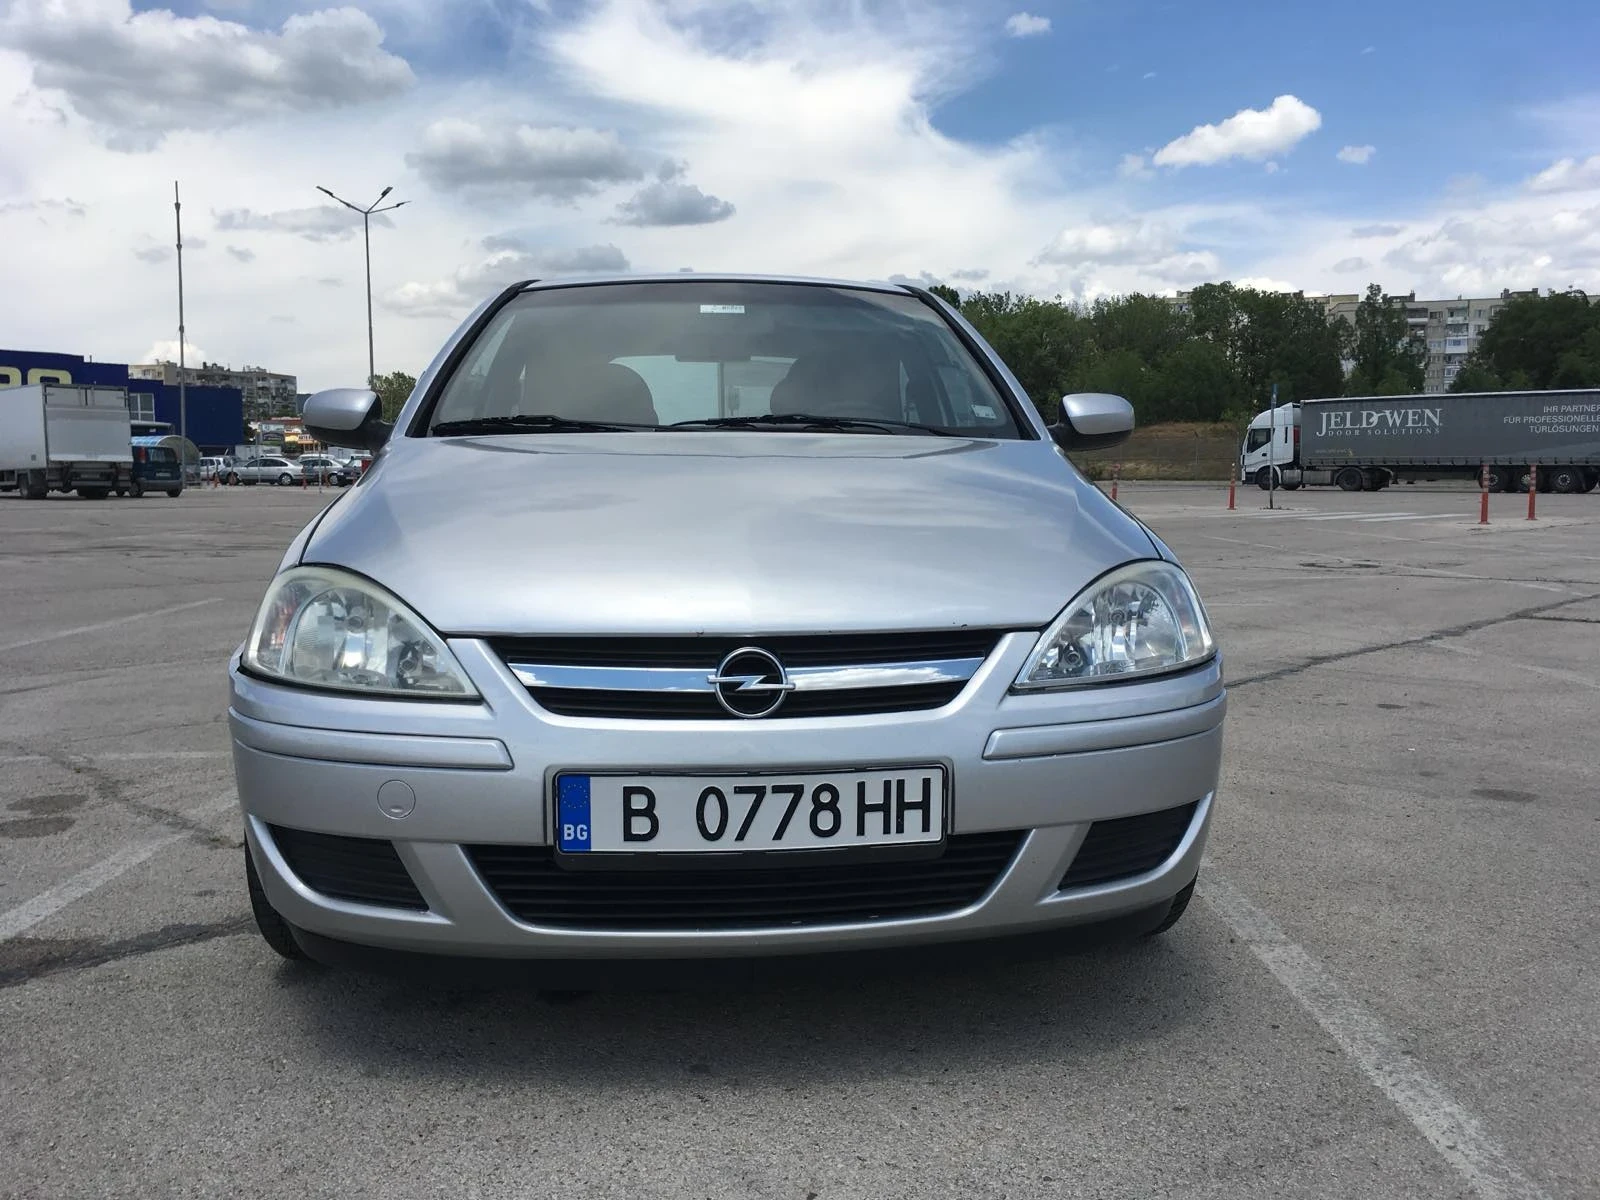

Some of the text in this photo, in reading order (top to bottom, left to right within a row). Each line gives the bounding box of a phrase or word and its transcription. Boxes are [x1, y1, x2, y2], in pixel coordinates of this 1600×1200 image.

[1543, 405, 1559, 413] IHR
[1328, 427, 1440, 437] DOOR SOLUTIONS
[622, 786, 660, 842] B
[563, 824, 588, 840] BG
